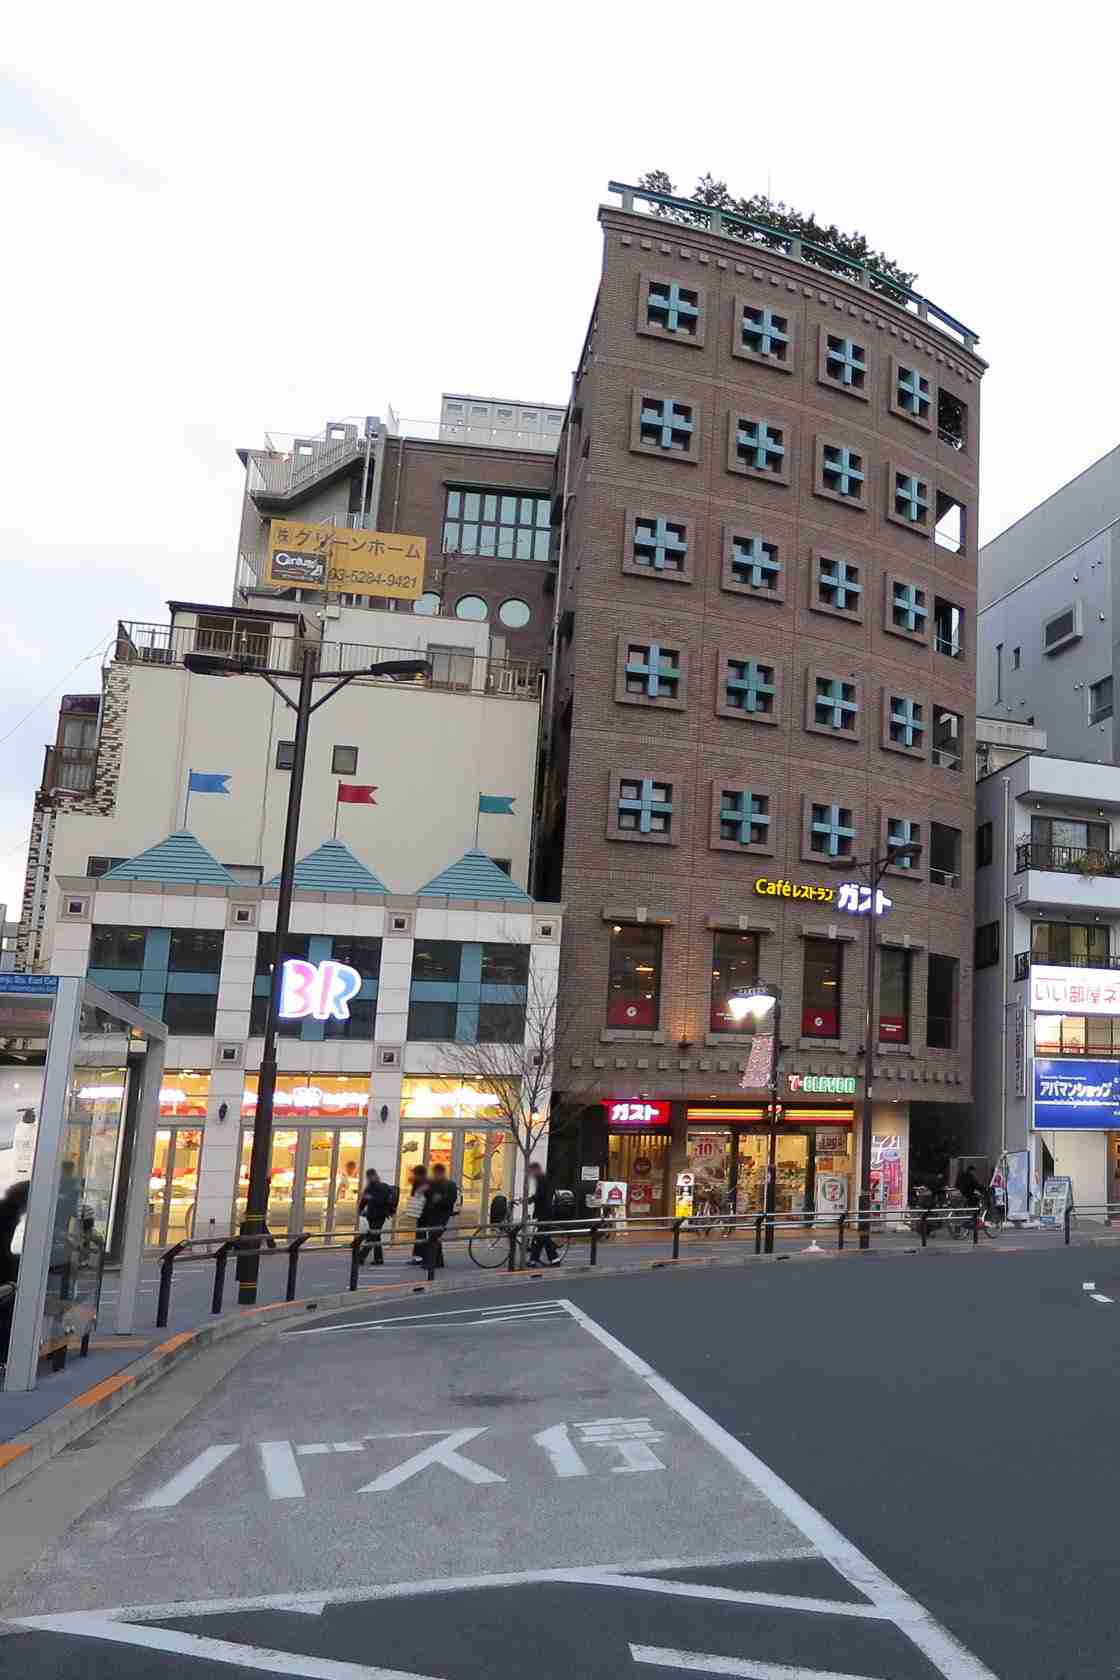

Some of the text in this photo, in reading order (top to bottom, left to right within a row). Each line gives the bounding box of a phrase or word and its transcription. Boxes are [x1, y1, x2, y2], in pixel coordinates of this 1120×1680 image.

[755, 879, 791, 897] Café
[792, 885, 833, 900] レストラン
[279, 960, 361, 1019] BR
[611, 1104, 660, 1121] ガスト
[124, 1417, 668, 1512] バス停
